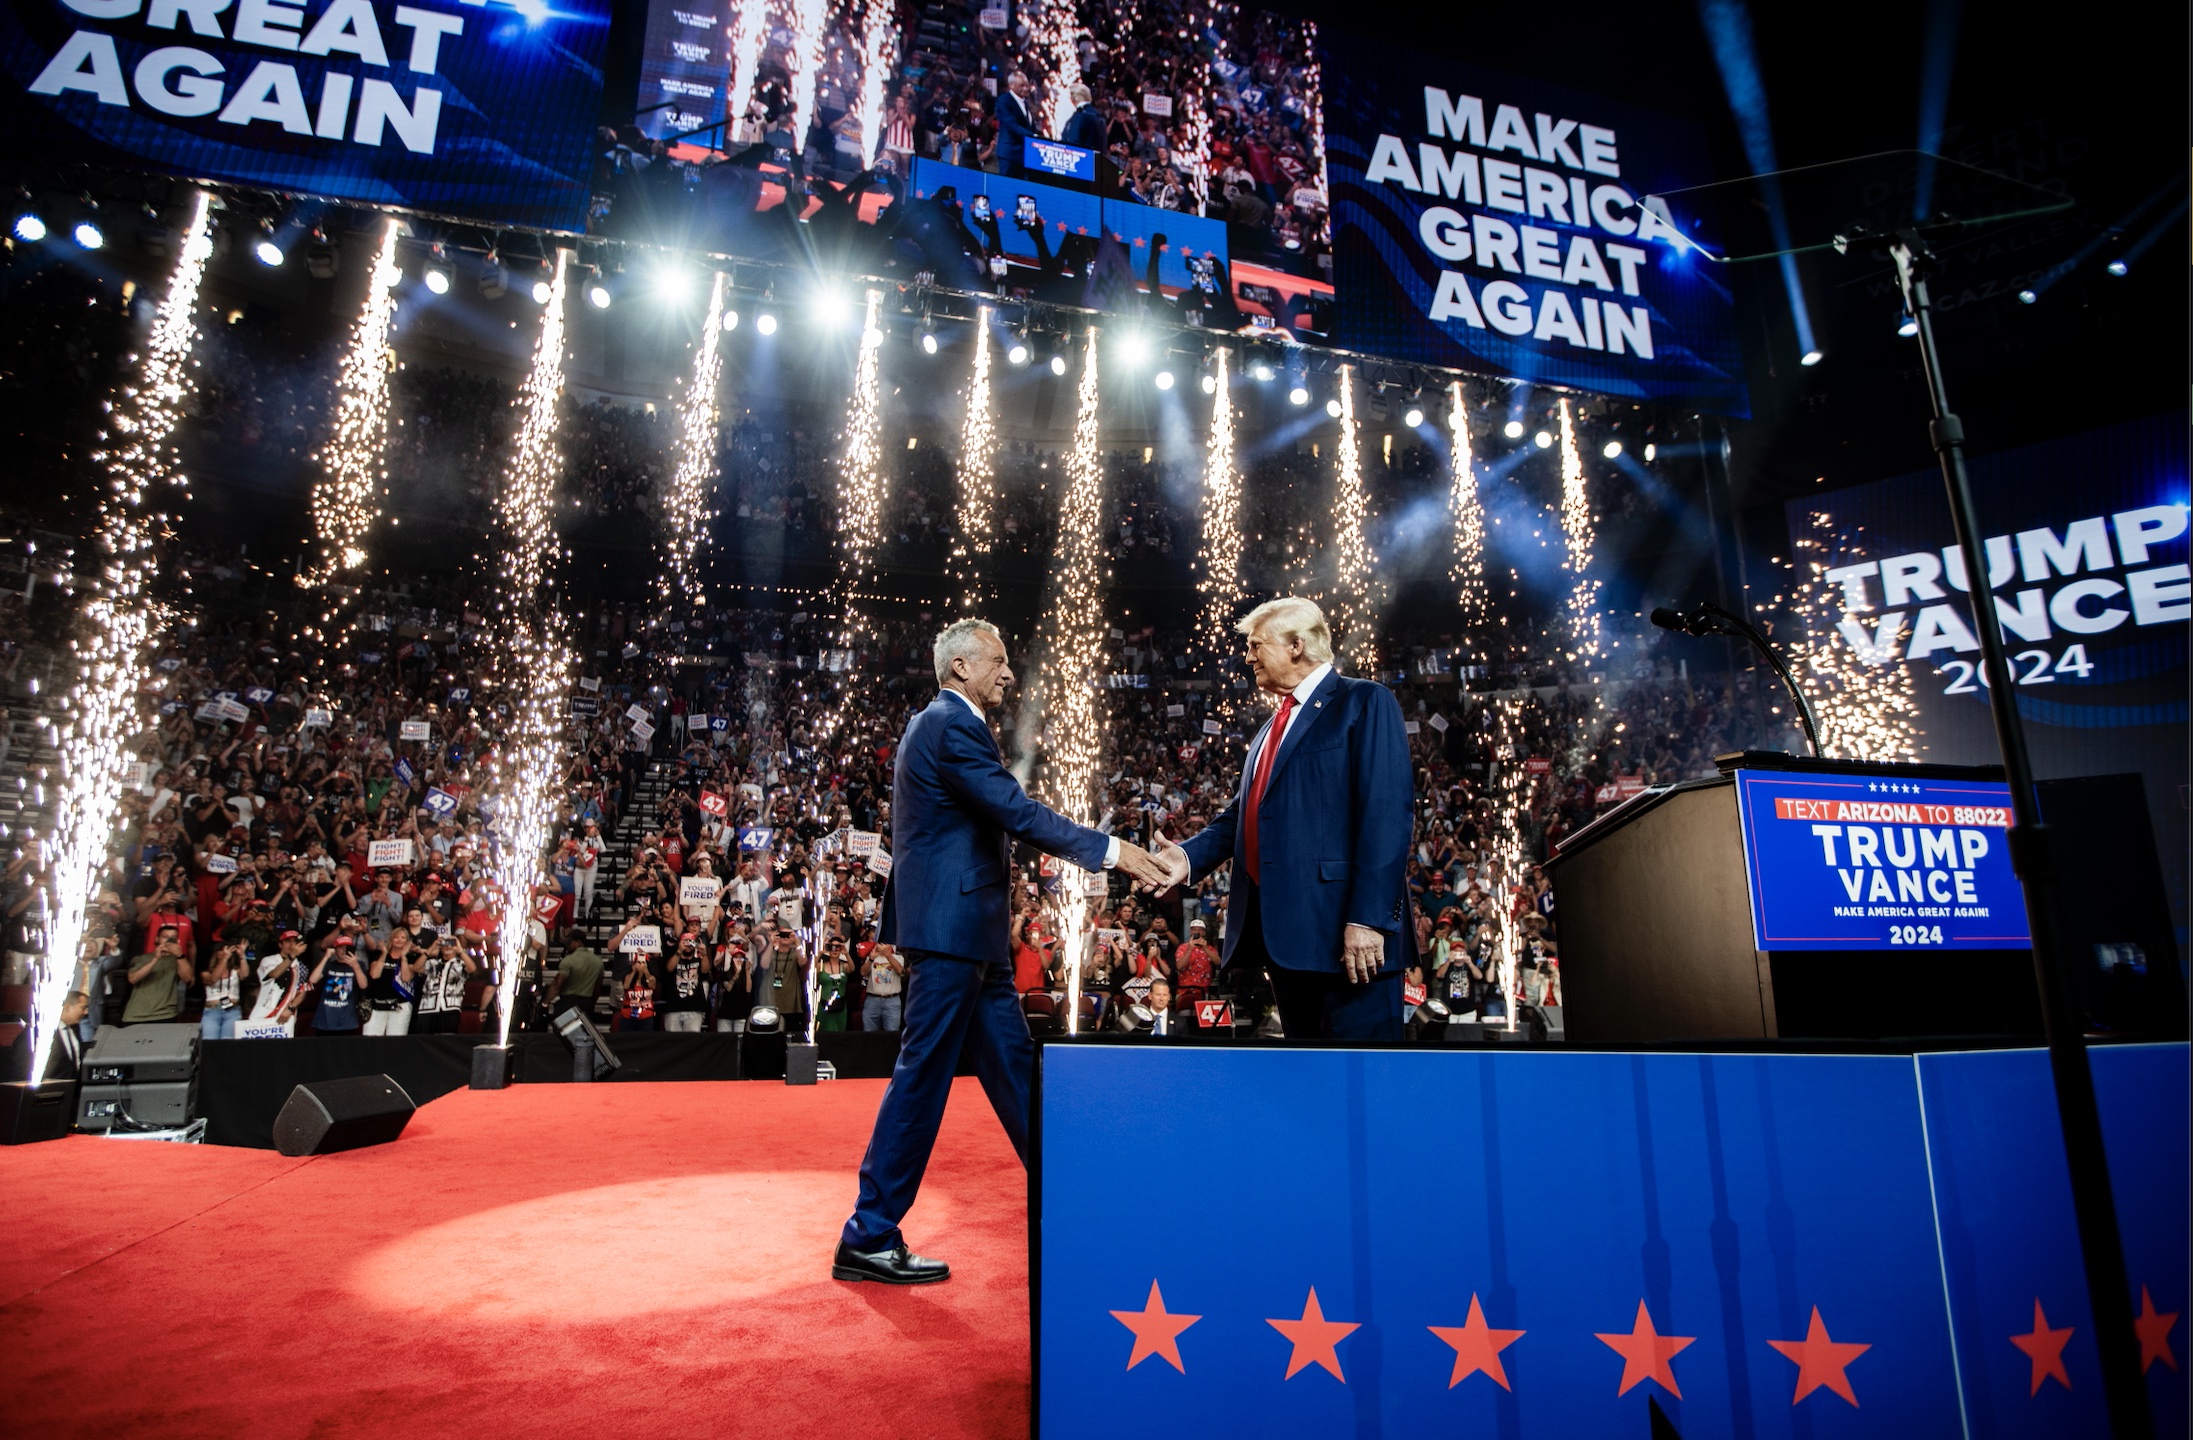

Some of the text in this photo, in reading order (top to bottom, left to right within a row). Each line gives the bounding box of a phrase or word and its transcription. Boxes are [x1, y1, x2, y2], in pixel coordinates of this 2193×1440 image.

[673, 41, 711, 54] TRUMP
[1214, 60, 1238, 77] 47
[28, 30, 443, 155] AGAIN
[1241, 88, 1263, 104] 47
[1424, 85, 1620, 178] MAKE
[1039, 149, 1081, 163] TRUMP
[1043, 156, 1076, 170] VANCE
[1278, 156, 1304, 174] 47
[1365, 133, 1688, 257] AMERICA
[1419, 205, 1647, 297] GREAT
[1428, 270, 1654, 360] AGAIN
[1824, 505, 2189, 612] TRUMP
[1836, 563, 2192, 664] VANCE
[160, 659, 181, 671] 47
[249, 688, 273, 702] 47
[451, 688, 469, 700] 47
[712, 718, 727, 730] 47
[1180, 749, 1196, 758] 47
[1598, 787, 1618, 799] 47
[428, 794, 455, 815] 47
[703, 796, 726, 812] 47
[1782, 799, 2008, 826] TEXT ARIZONA TO 88022
[743, 831, 770, 847] 47
[1811, 824, 1990, 869] TRUMP
[1837, 868, 1979, 904] VANCE
[684, 891, 716, 899] FIRED!
[1833, 906, 1990, 918] MAKE AMERICA GREAT AGAIN!
[623, 939, 657, 947] FIRED!
[1889, 925, 1944, 945] 2024
[1201, 1005, 1226, 1023] 47
[245, 1026, 285, 1036] YOU'RE
